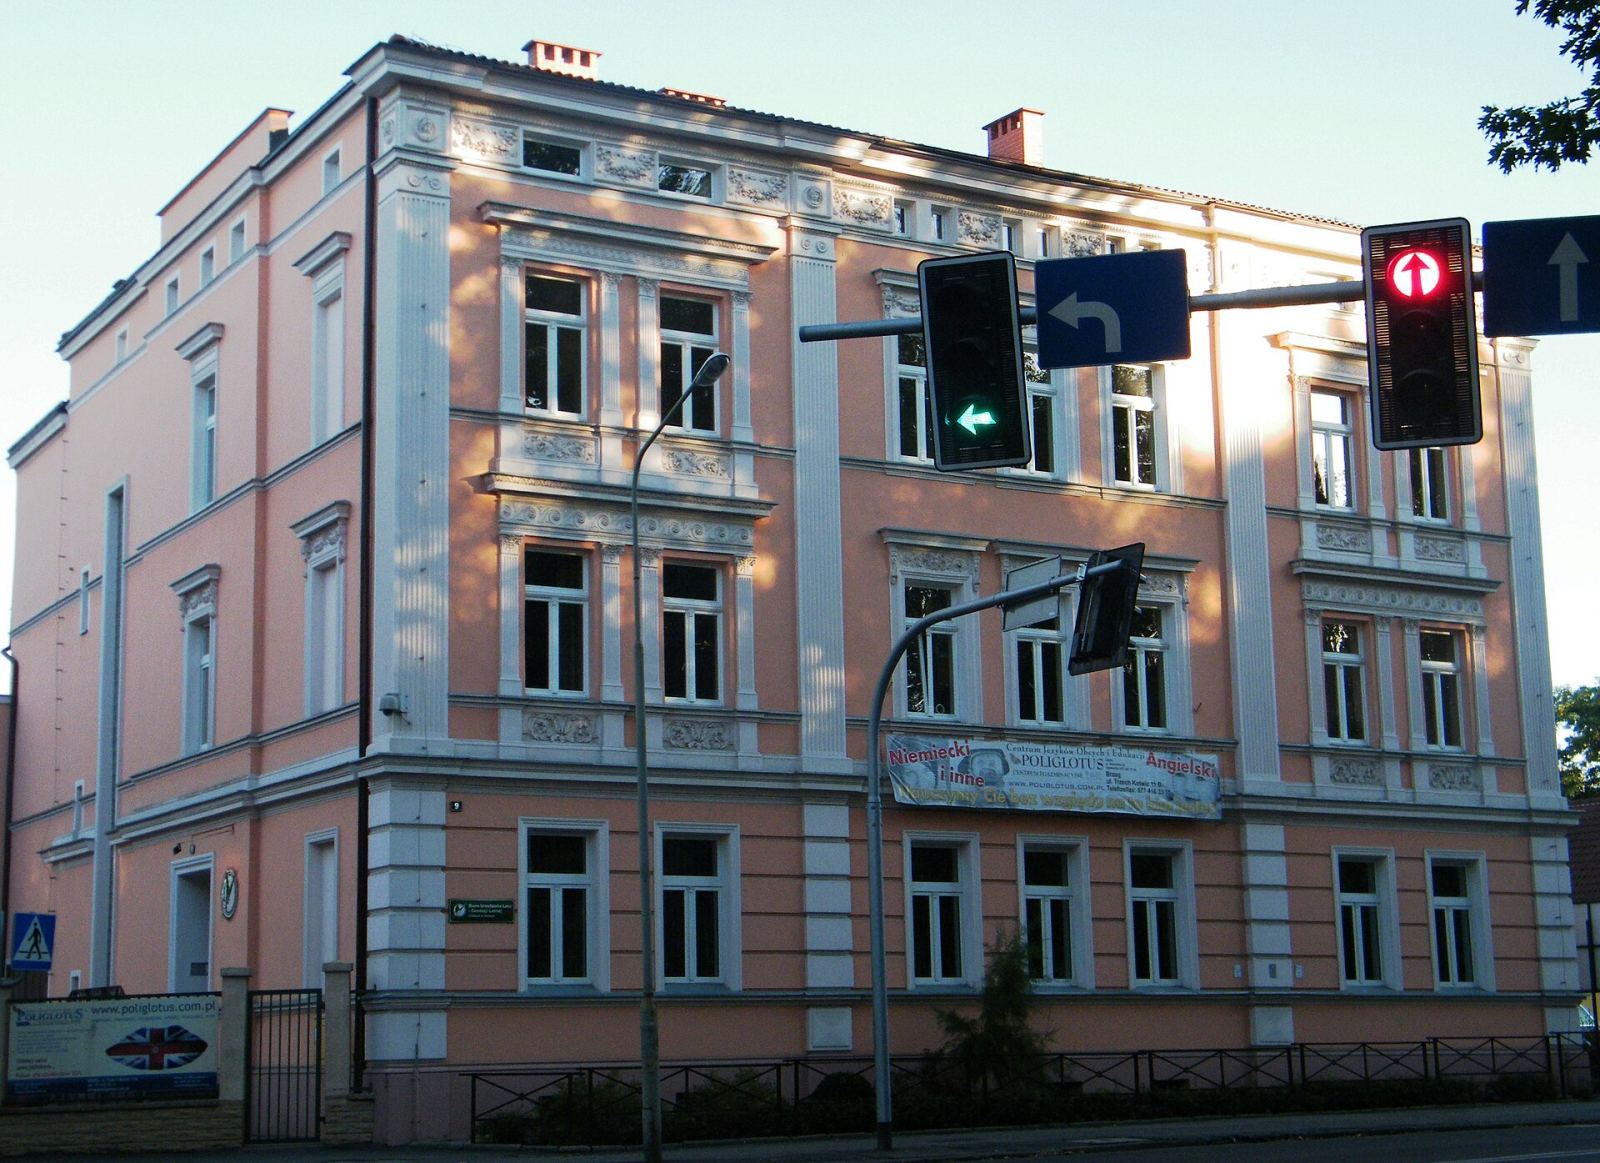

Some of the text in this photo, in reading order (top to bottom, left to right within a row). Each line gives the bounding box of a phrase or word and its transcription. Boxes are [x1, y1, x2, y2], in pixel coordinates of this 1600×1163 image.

[888, 738, 971, 766] Niemiecki
[1006, 743, 1041, 753] Centrum
[1022, 754, 1105, 770] POLIGLOTUS
[1146, 752, 1215, 778] Angielski
[949, 766, 985, 788] inne
[454, 802, 460, 810] 9
[91, 1000, 216, 1016] www.poliglotus.com.pl
